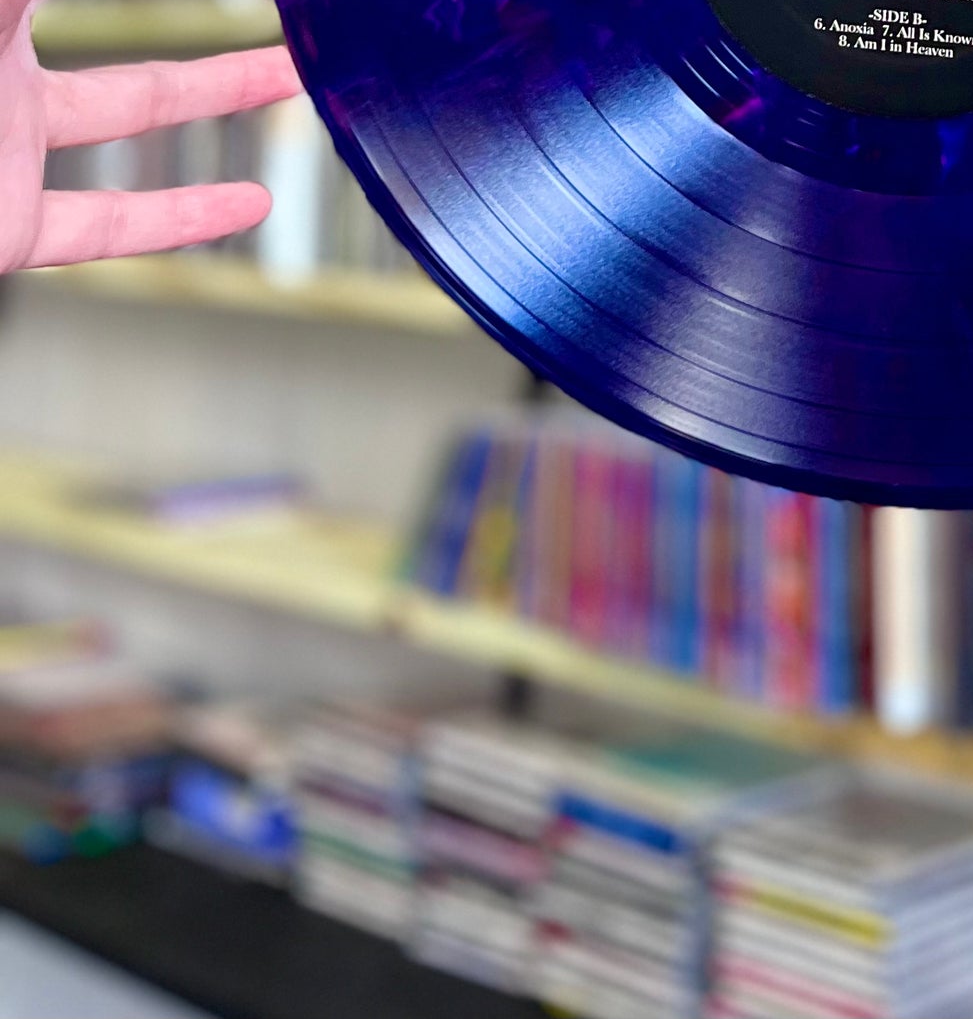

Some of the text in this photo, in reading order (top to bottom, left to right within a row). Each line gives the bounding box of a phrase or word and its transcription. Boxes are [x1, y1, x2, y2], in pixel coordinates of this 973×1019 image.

[813, 17, 826, 31] 6.
[829, 19, 874, 36] Anoxia
[882, 24, 894, 38] 7.
[896, 26, 915, 41] All
[918, 29, 931, 42] Is
[868, 8, 927, 26] -SIDE B-
[838, 34, 954, 59] 8. Am I in Heaven
